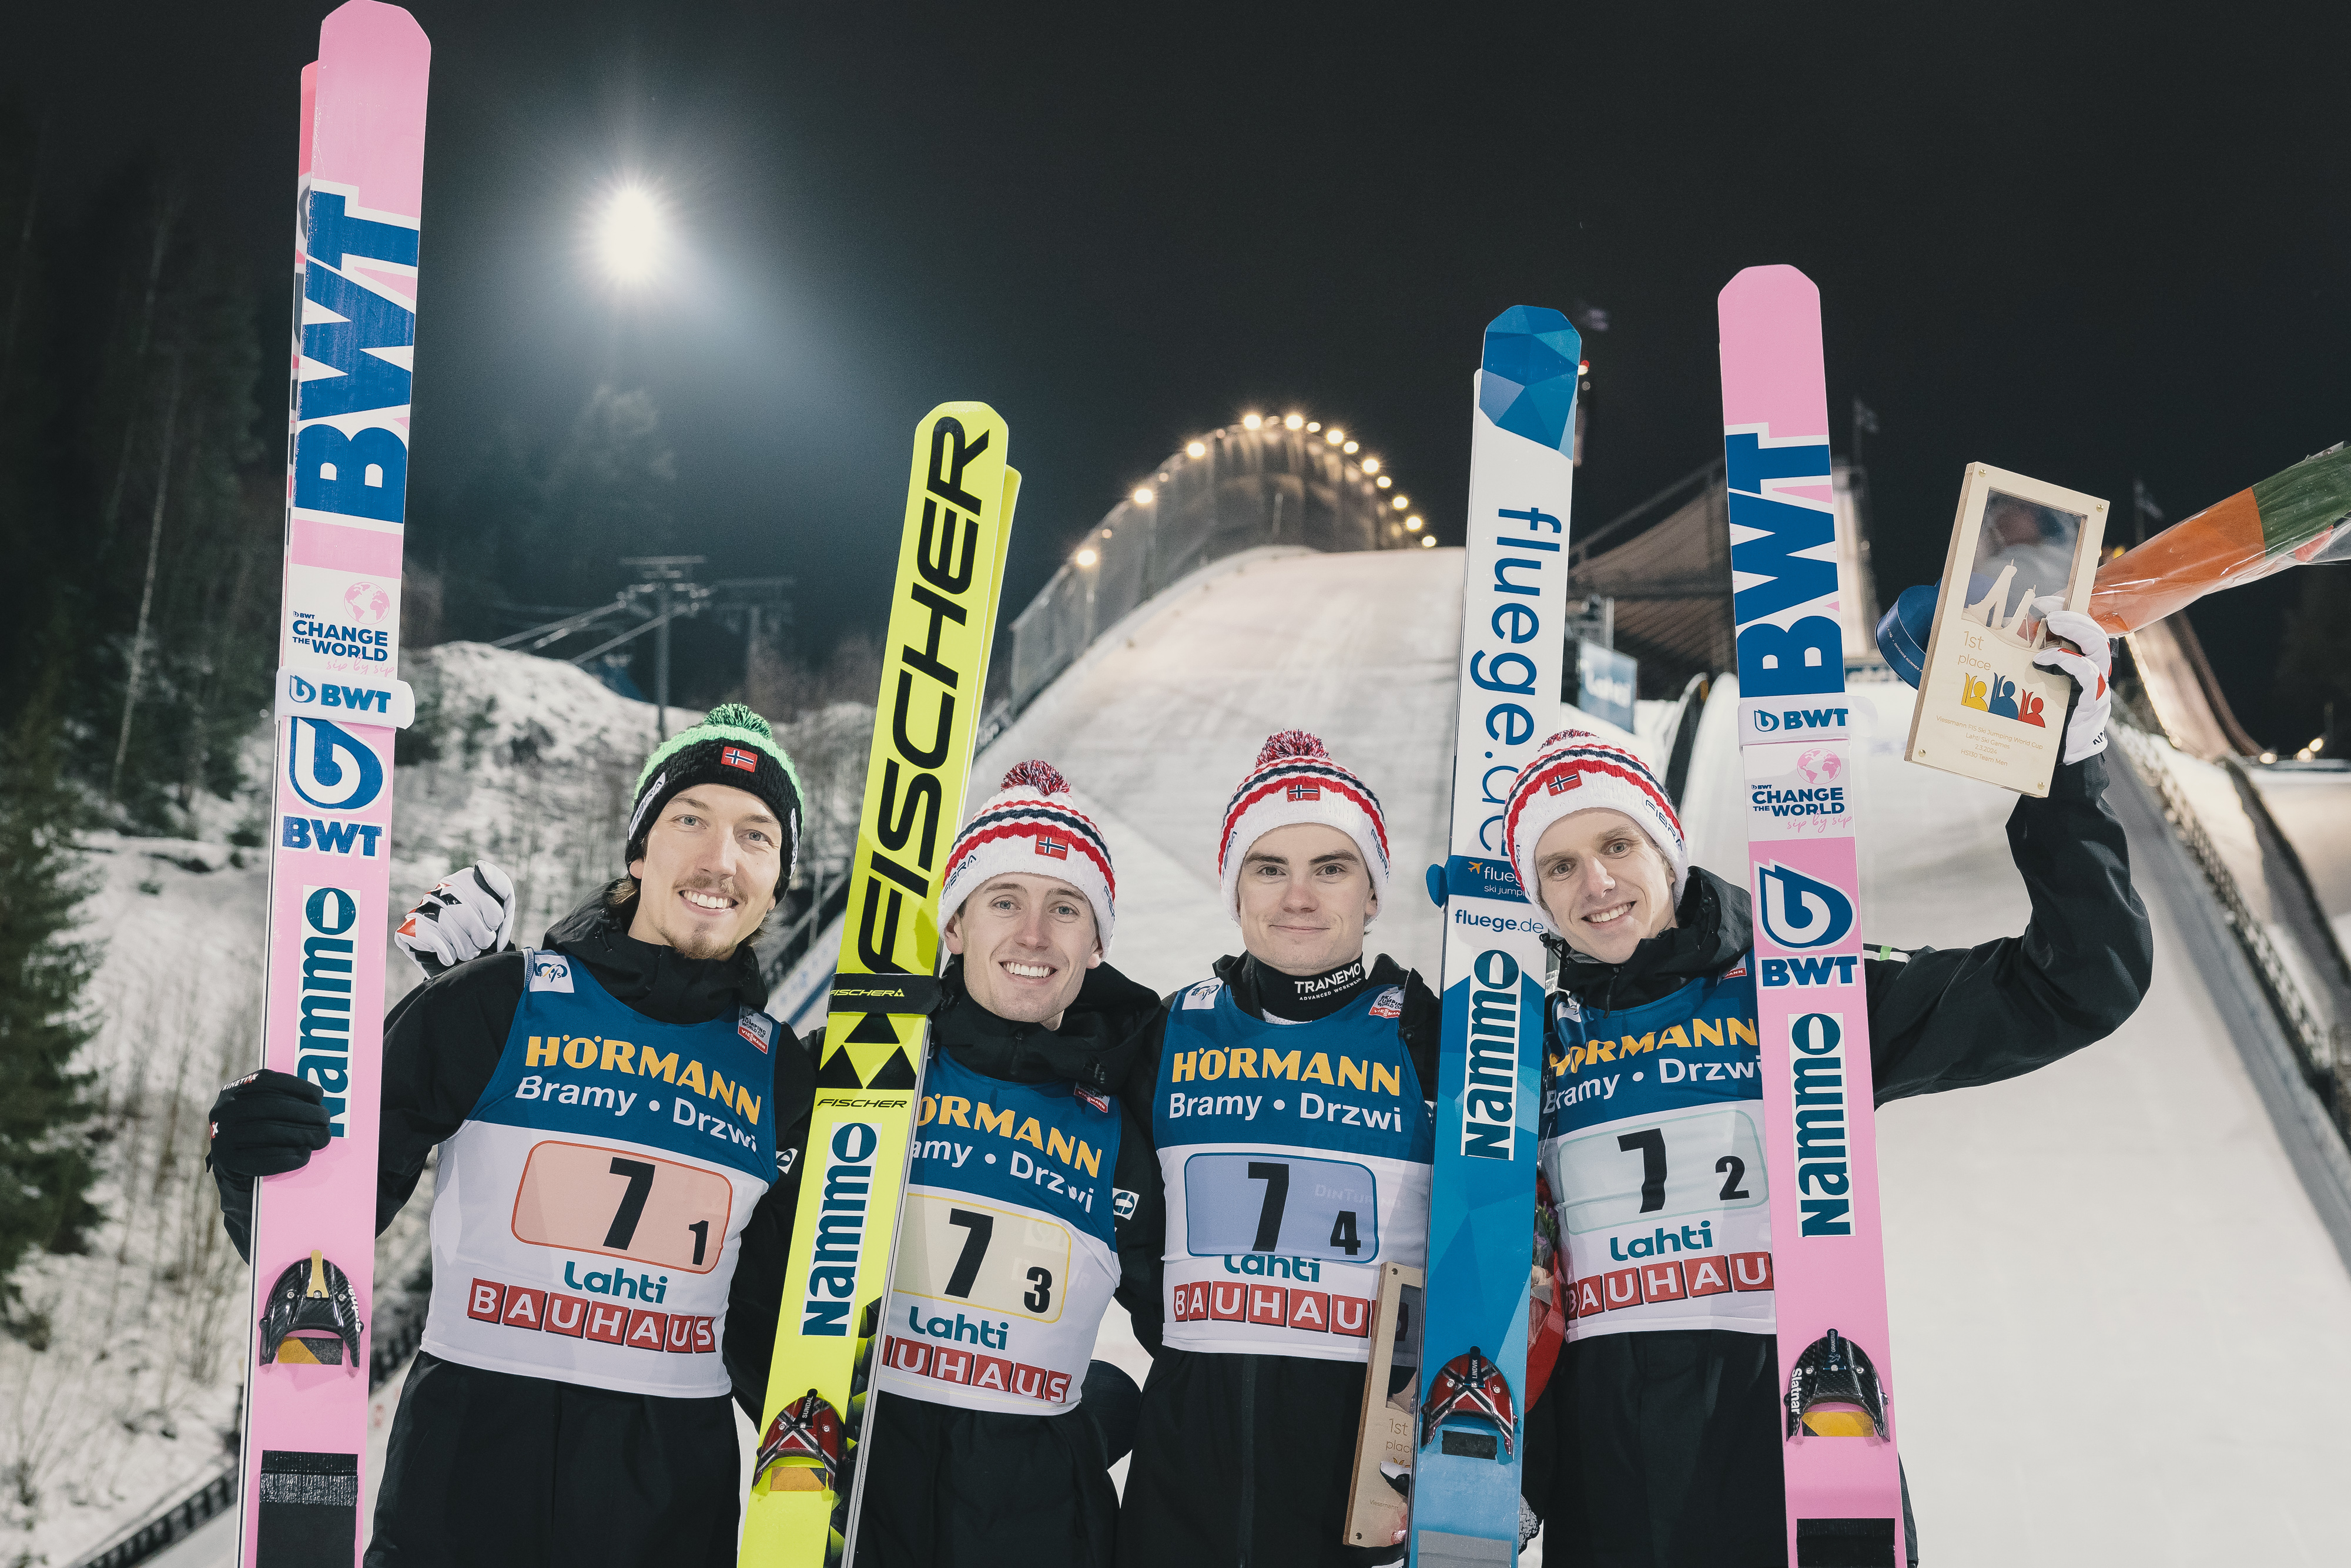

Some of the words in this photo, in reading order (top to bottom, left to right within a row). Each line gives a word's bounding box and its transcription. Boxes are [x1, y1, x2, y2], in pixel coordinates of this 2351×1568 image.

[293, 190, 420, 524] BWT
[1726, 433, 1845, 698] BWT
[293, 620, 388, 646] CHANGE
[293, 636, 310, 645] THE
[312, 639, 388, 662] WORLD
[1964, 631, 1984, 651] 1st
[326, 659, 348, 672] sip
[353, 654, 369, 675] by
[373, 664, 394, 677] sip
[1905, 657, 1920, 671] KOMMER
[1958, 654, 1991, 671] place
[321, 684, 391, 713] BWT
[858, 416, 990, 974] FISCHER
[1784, 708, 1848, 730] BWT
[1936, 715, 1967, 728] Viessmann
[1987, 729, 2012, 742] Jumping
[2014, 736, 2030, 746] World
[1961, 749, 1978, 758] HS130
[1978, 753, 1994, 762] Team
[1995, 758, 2008, 766] Men
[1965, 732, 1980, 741] Lahti
[1990, 739, 2010, 749] Games
[1975, 743, 1997, 755] 2.3.2024
[1751, 788, 1844, 805] CHANGE
[1770, 802, 1845, 817] WORLD
[282, 816, 383, 856] BWT
[1646, 799, 1682, 852] FIBRA
[1787, 817, 1807, 833] sip
[1811, 810, 1826, 833] by
[1832, 815, 1853, 829] sip
[943, 855, 977, 900] FIBRA
[1455, 909, 1544, 933] fluege.de
[1294, 963, 1361, 993] TRANEMO
[1300, 991, 1332, 1000] ADVANCED
[1334, 977, 1362, 993] WORKWEAR
[1761, 956, 1857, 987] BWT
[1379, 999, 1403, 1007] JUMPIN
[742, 1021, 757, 1033] WORLD
[1172, 1047, 1399, 1096] HÖRMANN
[1465, 949, 1519, 1160] Nammo
[525, 1035, 761, 1125] HÖRMANN
[515, 1076, 638, 1116] Bramy
[674, 1097, 758, 1152] Drzwi
[817, 1099, 907, 1108] FISCHER
[1170, 1093, 1262, 1121] Bramy
[1300, 1093, 1402, 1133] Drzwi
[917, 1093, 1102, 1178] ÖRMANN
[1792, 1013, 1851, 1238] Nammo
[1010, 1151, 1094, 1213] Drzwi
[1617, 1128, 1667, 1214] 7
[1715, 1155, 1750, 1201] 2
[603, 1157, 655, 1250] 7
[1248, 1161, 1290, 1252] 7
[688, 1219, 709, 1265] 1
[802, 1123, 877, 1336] Nammo
[1330, 1210, 1361, 1255] 4
[1610, 1220, 1713, 1261] Lahti
[944, 1208, 994, 1299] 7
[564, 1261, 668, 1304] Lahti
[1024, 1267, 1053, 1314] 3
[1566, 1258, 1767, 1315] BAUHAU
[473, 1285, 712, 1346] BAUHAUS
[1175, 1286, 1364, 1329] BAUHAU
[909, 1306, 1009, 1351] Lahti
[897, 1344, 1068, 1402] UHAUS
[802, 1396, 813, 1419] SUNDAL
[1389, 1418, 1408, 1436] 1st
[1385, 1440, 1411, 1453] plac
